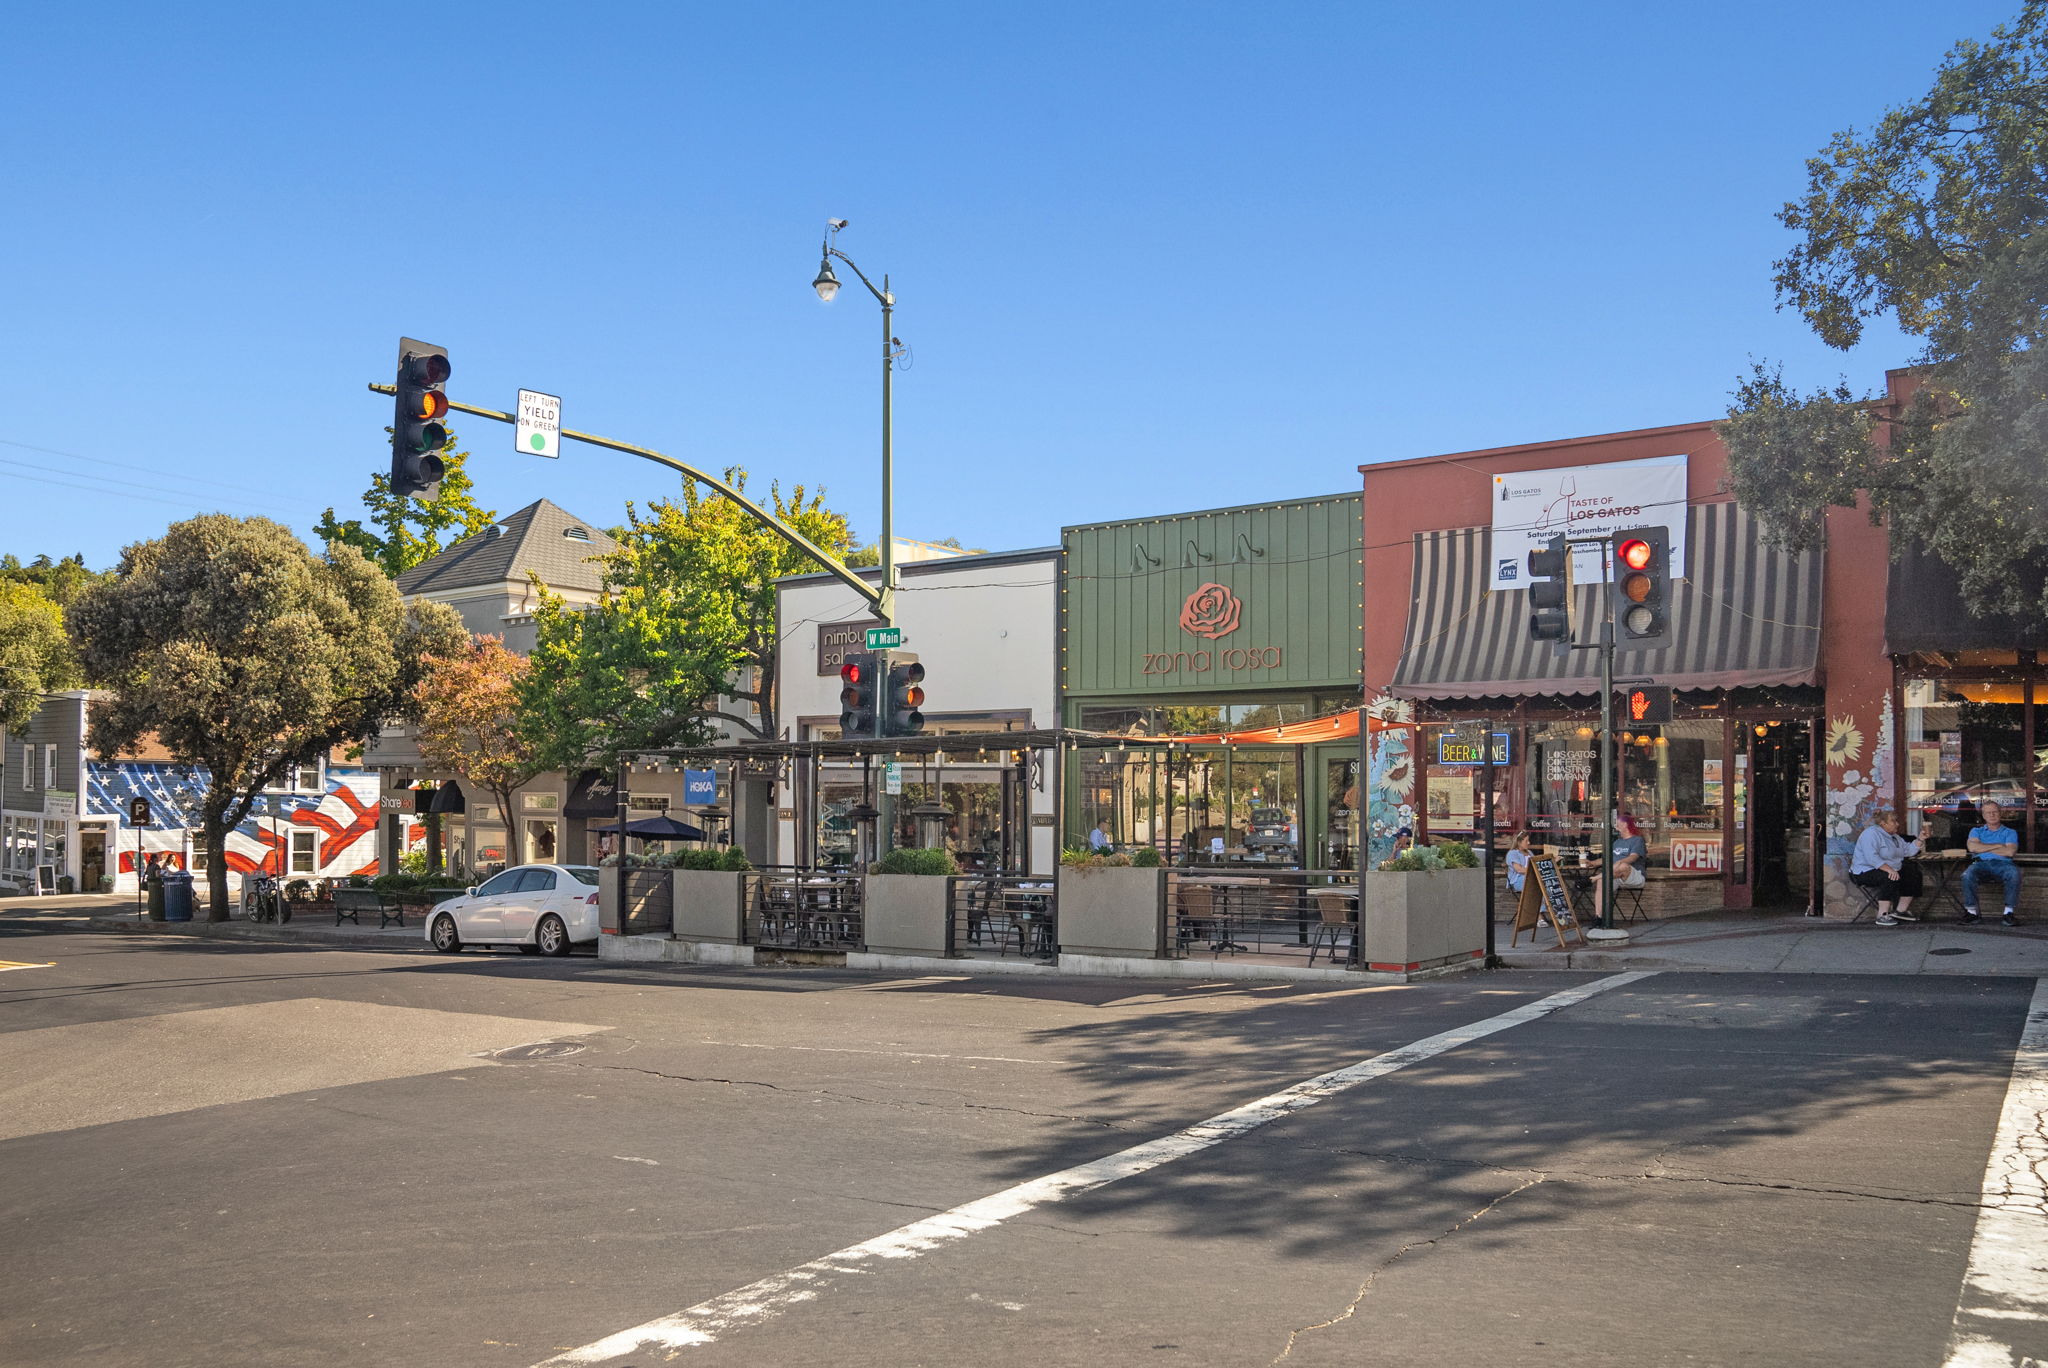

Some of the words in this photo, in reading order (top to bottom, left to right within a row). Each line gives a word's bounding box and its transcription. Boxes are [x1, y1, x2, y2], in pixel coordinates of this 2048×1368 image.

[520, 394, 537, 403] LEFT
[541, 398, 559, 408] TURN
[525, 405, 555, 420] YIELD
[520, 418, 530, 427] ON
[533, 421, 557, 432] GREEN
[1570, 498, 1599, 508] TASTE
[1600, 497, 1614, 505] OF
[1570, 509, 1594, 521] LOS
[1597, 505, 1641, 518] GATOS
[1567, 526, 1611, 536] September
[824, 625, 866, 646] nimbu
[869, 633, 877, 645] W
[880, 632, 899, 645] Main
[1141, 650, 1211, 674] zona
[1220, 646, 1281, 670] rosa
[1442, 744, 1470, 761] BEER
[1471, 748, 1477, 760] &
[1478, 743, 1506, 761] WNE
[1547, 751, 1567, 759] LOS
[1567, 751, 1597, 759] GATOS
[1547, 758, 1582, 766] COFFEE
[1547, 765, 1591, 774] ROASTING
[1547, 773, 1590, 781] COMPANY
[690, 781, 713, 793] HOKA
[1935, 797, 1960, 805] Mocha
[135, 804, 145, 816] P
[1531, 820, 1551, 828] Coffee
[1664, 821, 1683, 829] Bagels
[1690, 821, 1715, 829] Pastries
[1674, 843, 1718, 868] OPEN
